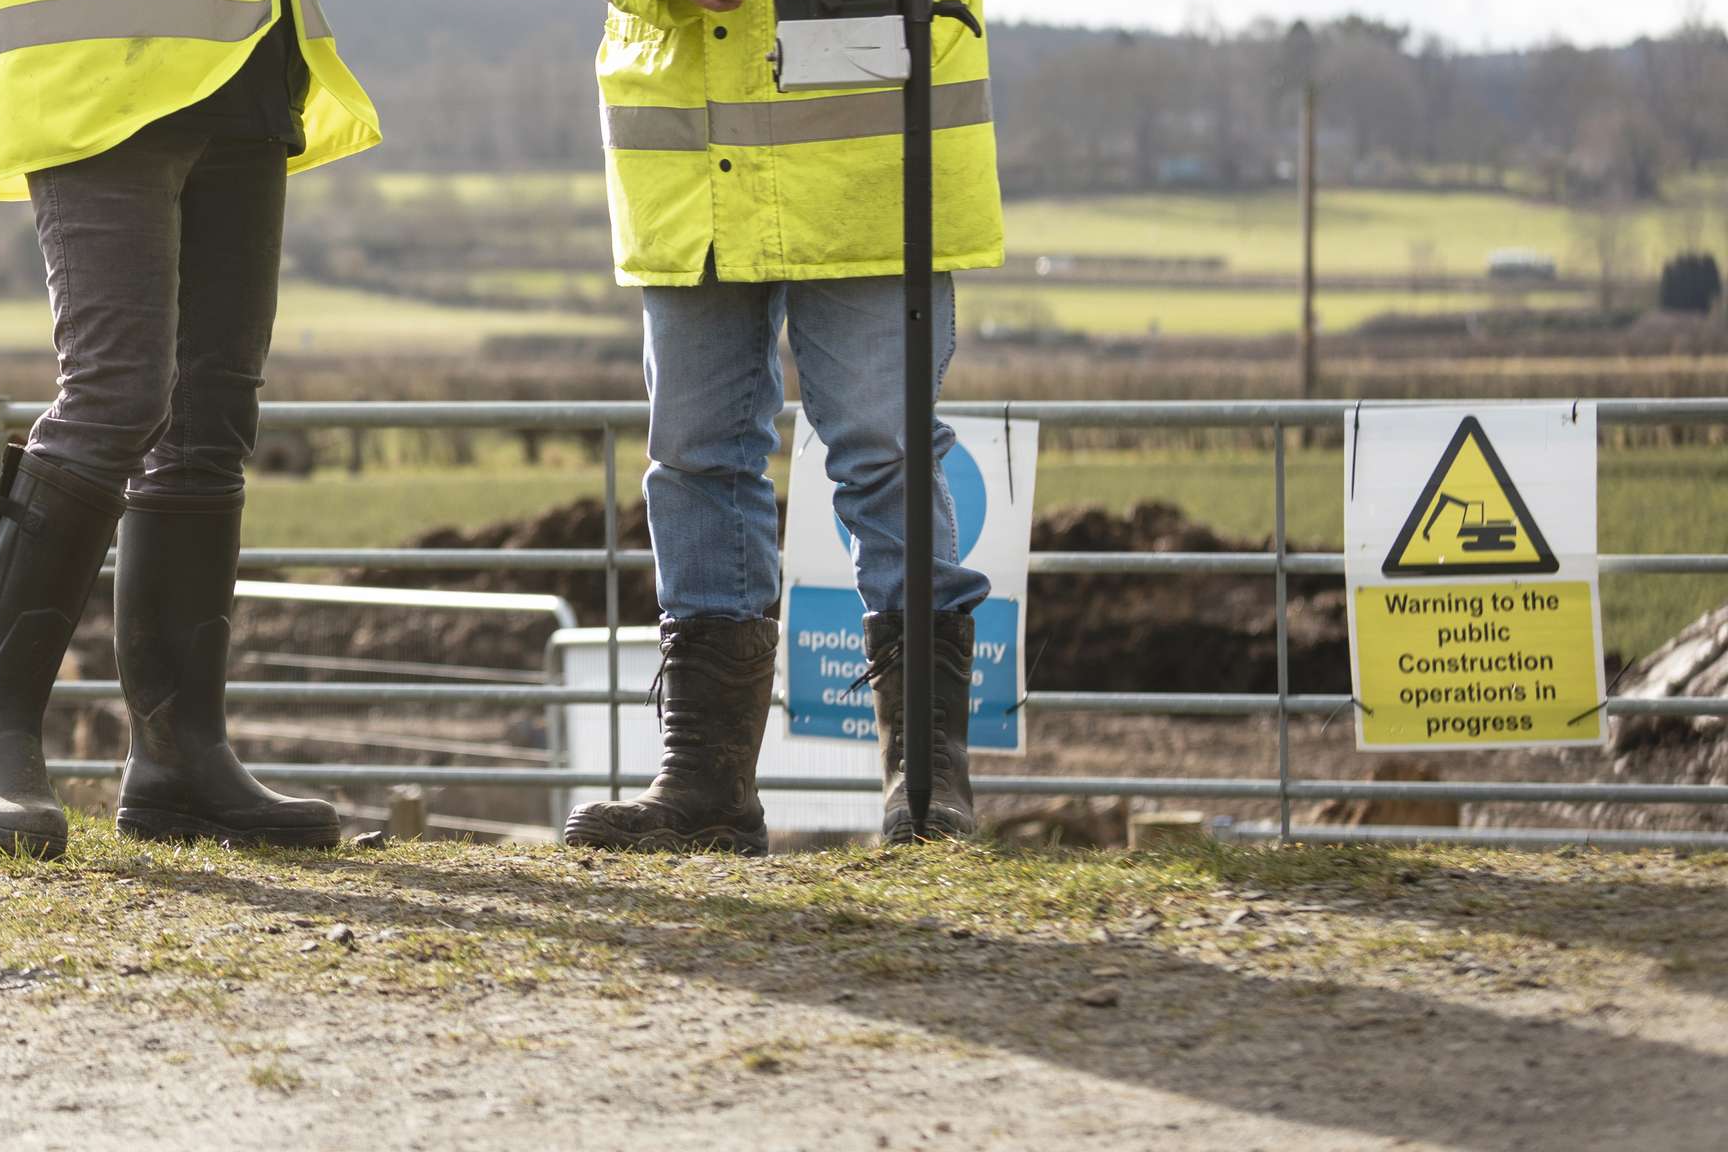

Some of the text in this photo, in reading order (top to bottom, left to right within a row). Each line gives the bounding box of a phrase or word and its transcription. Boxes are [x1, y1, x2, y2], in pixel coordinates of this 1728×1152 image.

[1385, 590, 1559, 617] Warning to the
[1438, 622, 1511, 647] public
[1398, 651, 1554, 674] Construction
[823, 687, 876, 708] caus
[1399, 680, 1557, 708] operations in
[1427, 714, 1533, 737] progress
